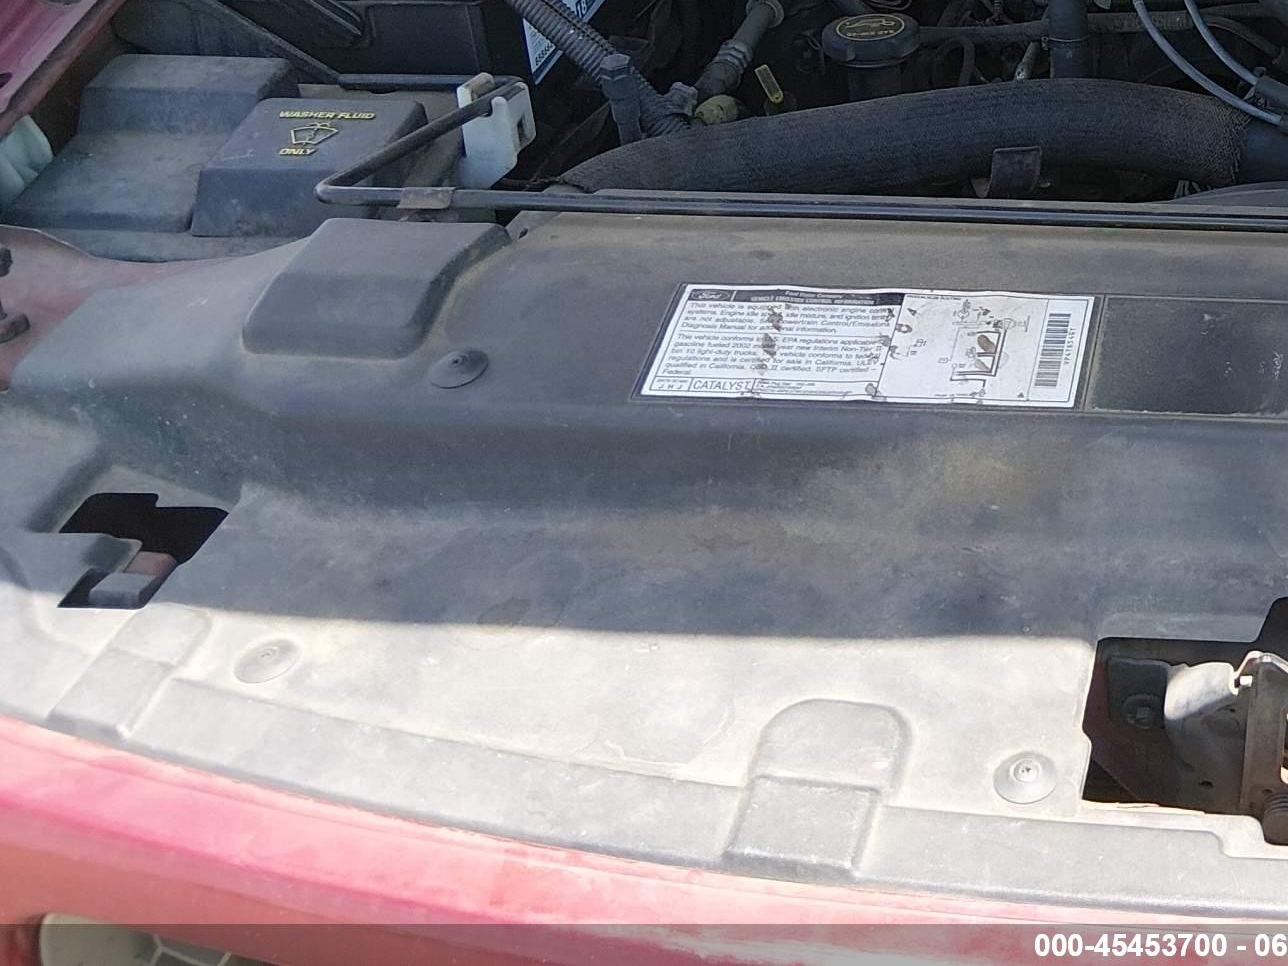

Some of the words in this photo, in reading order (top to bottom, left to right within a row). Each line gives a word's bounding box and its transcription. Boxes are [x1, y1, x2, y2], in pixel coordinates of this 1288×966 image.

[279, 110, 336, 119] WASHER
[336, 112, 376, 120] FLUID
[278, 148, 318, 156] ONLY
[720, 309, 744, 317] Engine
[697, 348, 732, 356] light-duty
[693, 380, 753, 391] CATALYST
